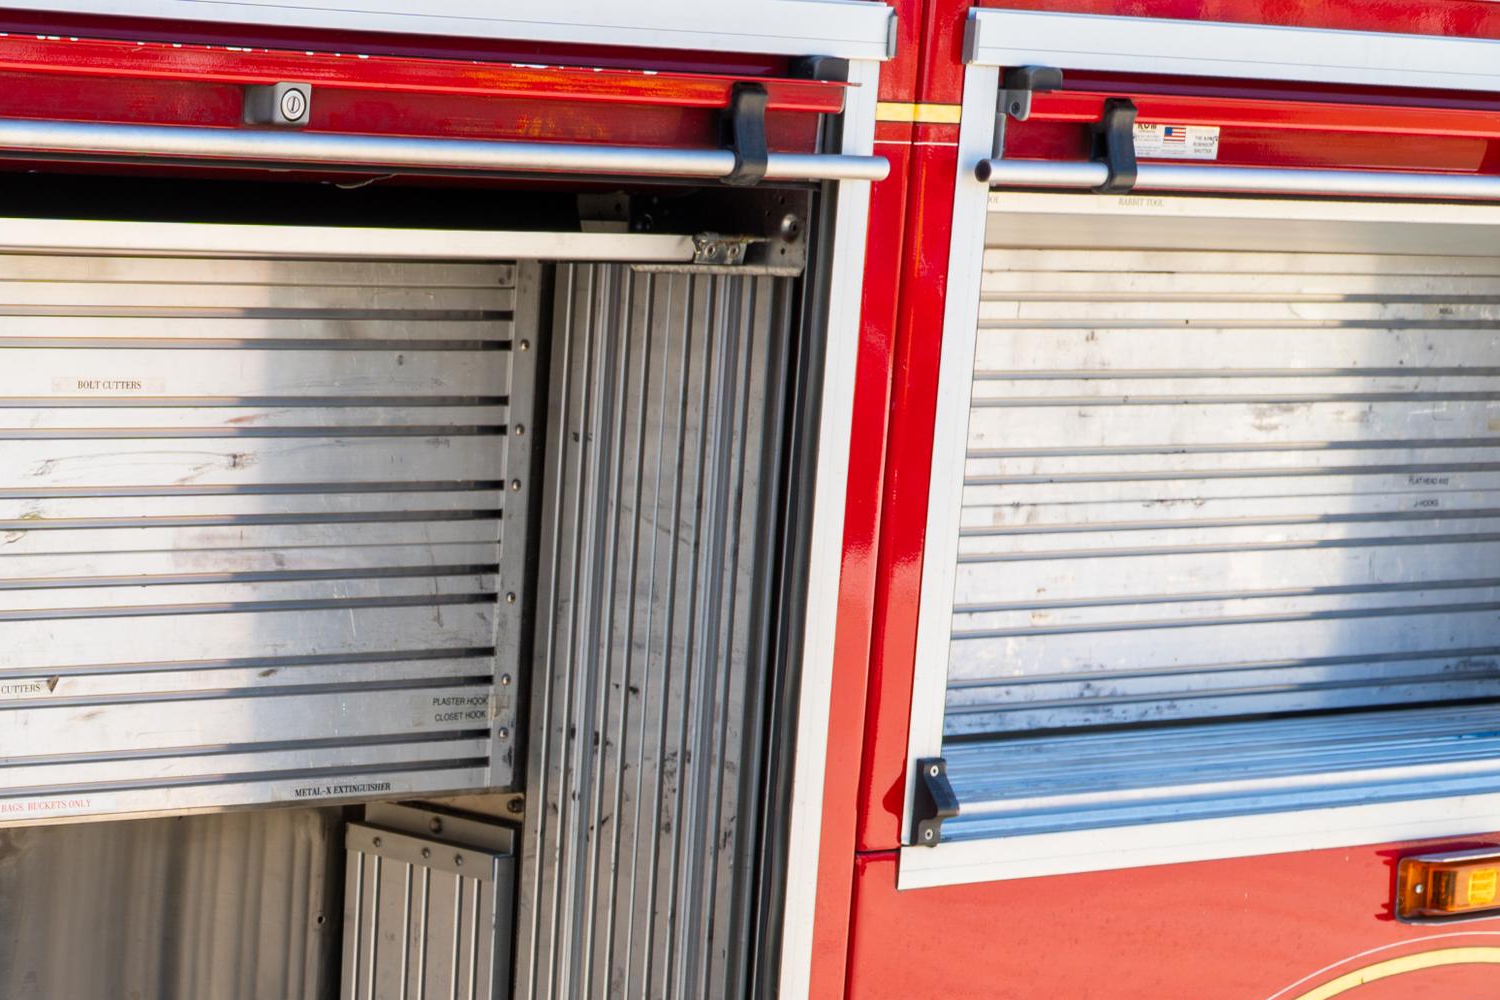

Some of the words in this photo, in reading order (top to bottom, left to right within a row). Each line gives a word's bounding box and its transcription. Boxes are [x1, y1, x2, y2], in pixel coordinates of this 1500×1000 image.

[77, 380, 101, 390] BOLT
[102, 380, 142, 391] CUTTERS
[0, 683, 41, 694] CUTTERS
[432, 696, 465, 707] PLASTER
[434, 711, 463, 722] CLOSET
[465, 709, 487, 721] HOOK
[334, 782, 391, 795] EXTINGUISHER
[27, 799, 68, 812] BUCKETS
[68, 798, 93, 810] ONLY
